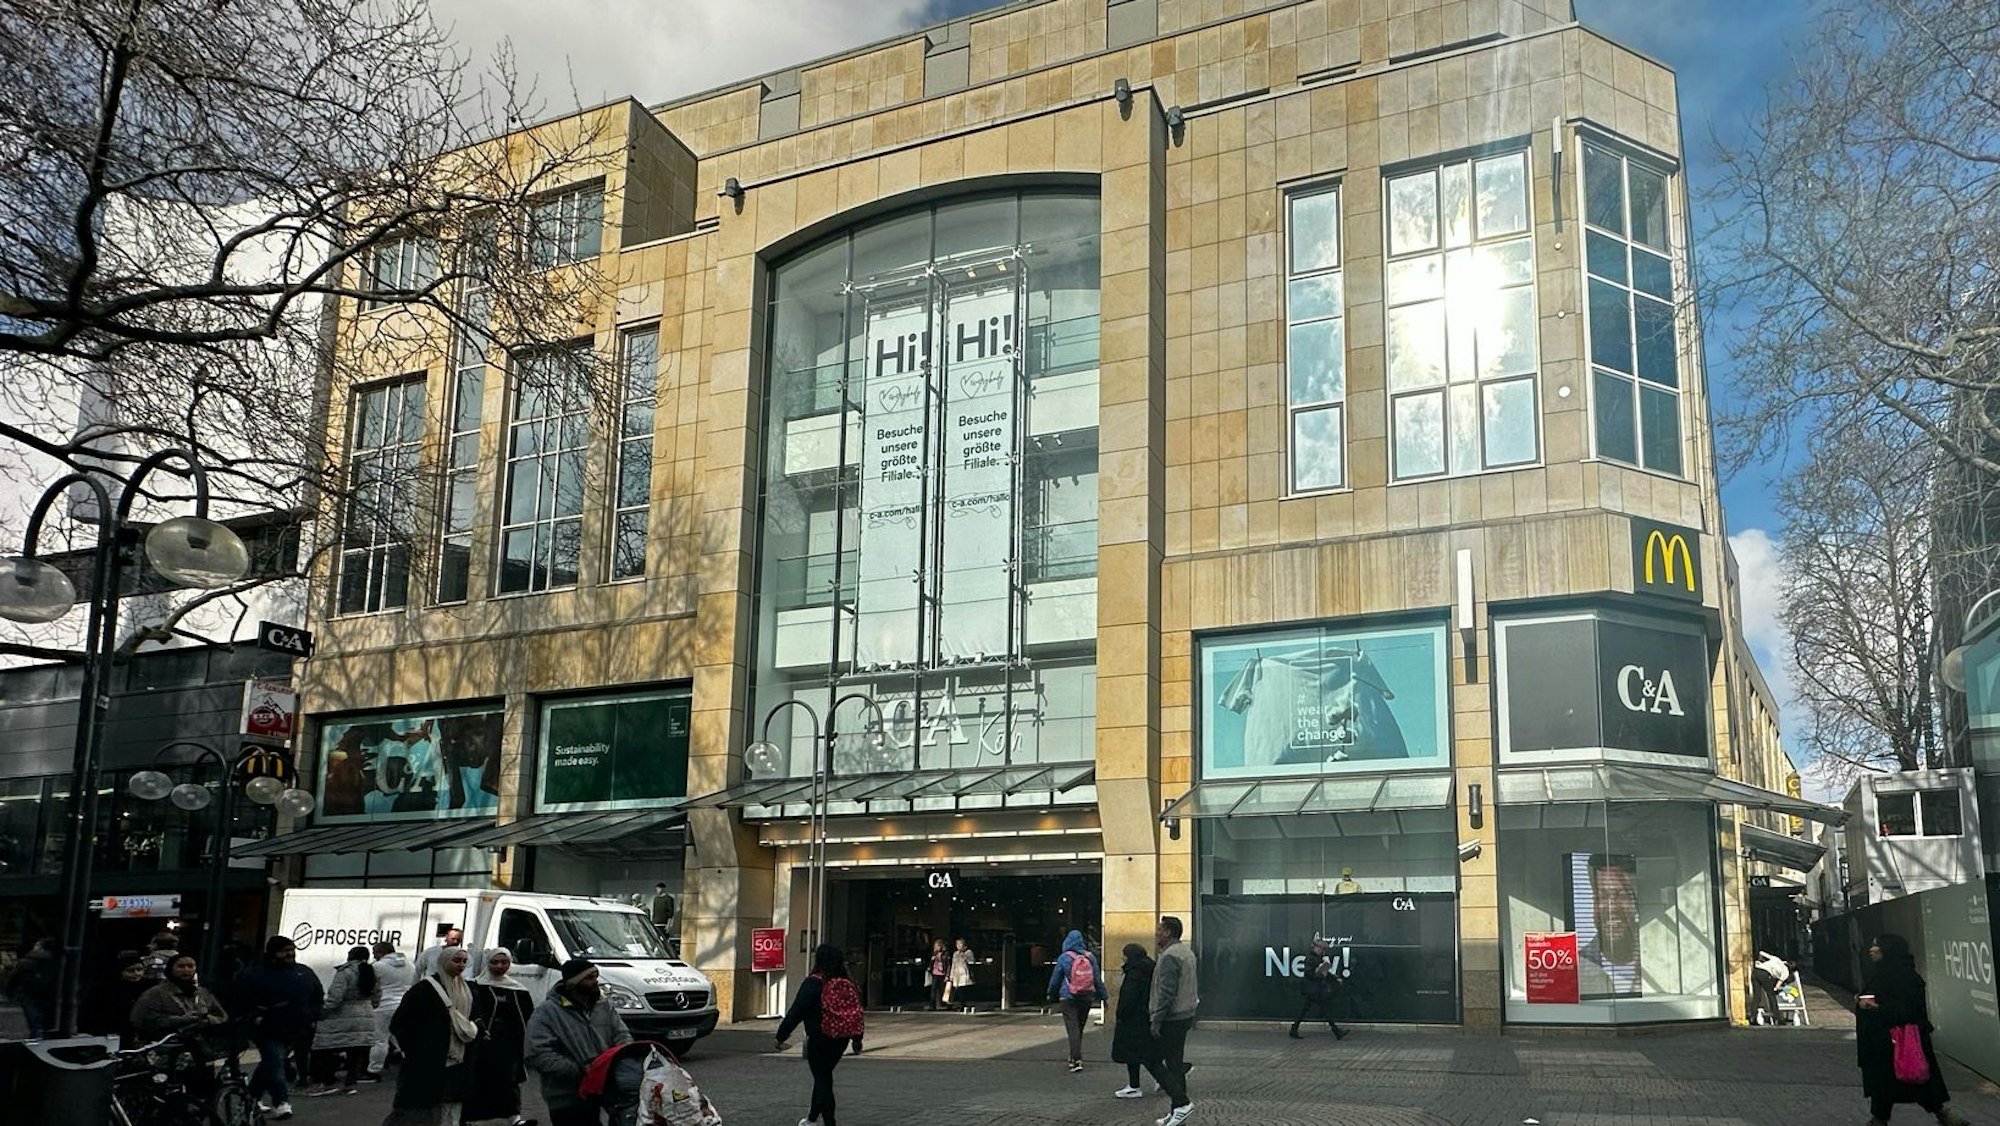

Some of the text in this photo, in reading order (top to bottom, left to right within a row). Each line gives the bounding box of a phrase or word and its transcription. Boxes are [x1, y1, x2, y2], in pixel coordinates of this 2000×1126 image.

[957, 315, 1013, 362] Hi!
[959, 410, 1008, 427] Besuche
[877, 424, 923, 440] Besuche
[963, 426, 1002, 441] unsere
[881, 440, 918, 454] unsere
[963, 441, 1001, 458] größte
[881, 454, 918, 471] größte
[963, 457, 1001, 470] Filiale.
[881, 469, 917, 482] Filiale.
[951, 494, 1011, 508] c-a.com/hallo
[268, 628, 304, 651] C&A
[1617, 664, 1685, 716] C&A
[1297, 705, 1329, 715] wear
[1297, 716, 1320, 728] the
[1297, 728, 1346, 742] change
[554, 741, 610, 756] Sustainability
[554, 756, 600, 767] made easy.
[928, 872, 953, 888] C&A
[313, 928, 403, 947] PROSEGUR
[755, 938, 783, 951] 50%
[1528, 949, 1573, 970] 50%
